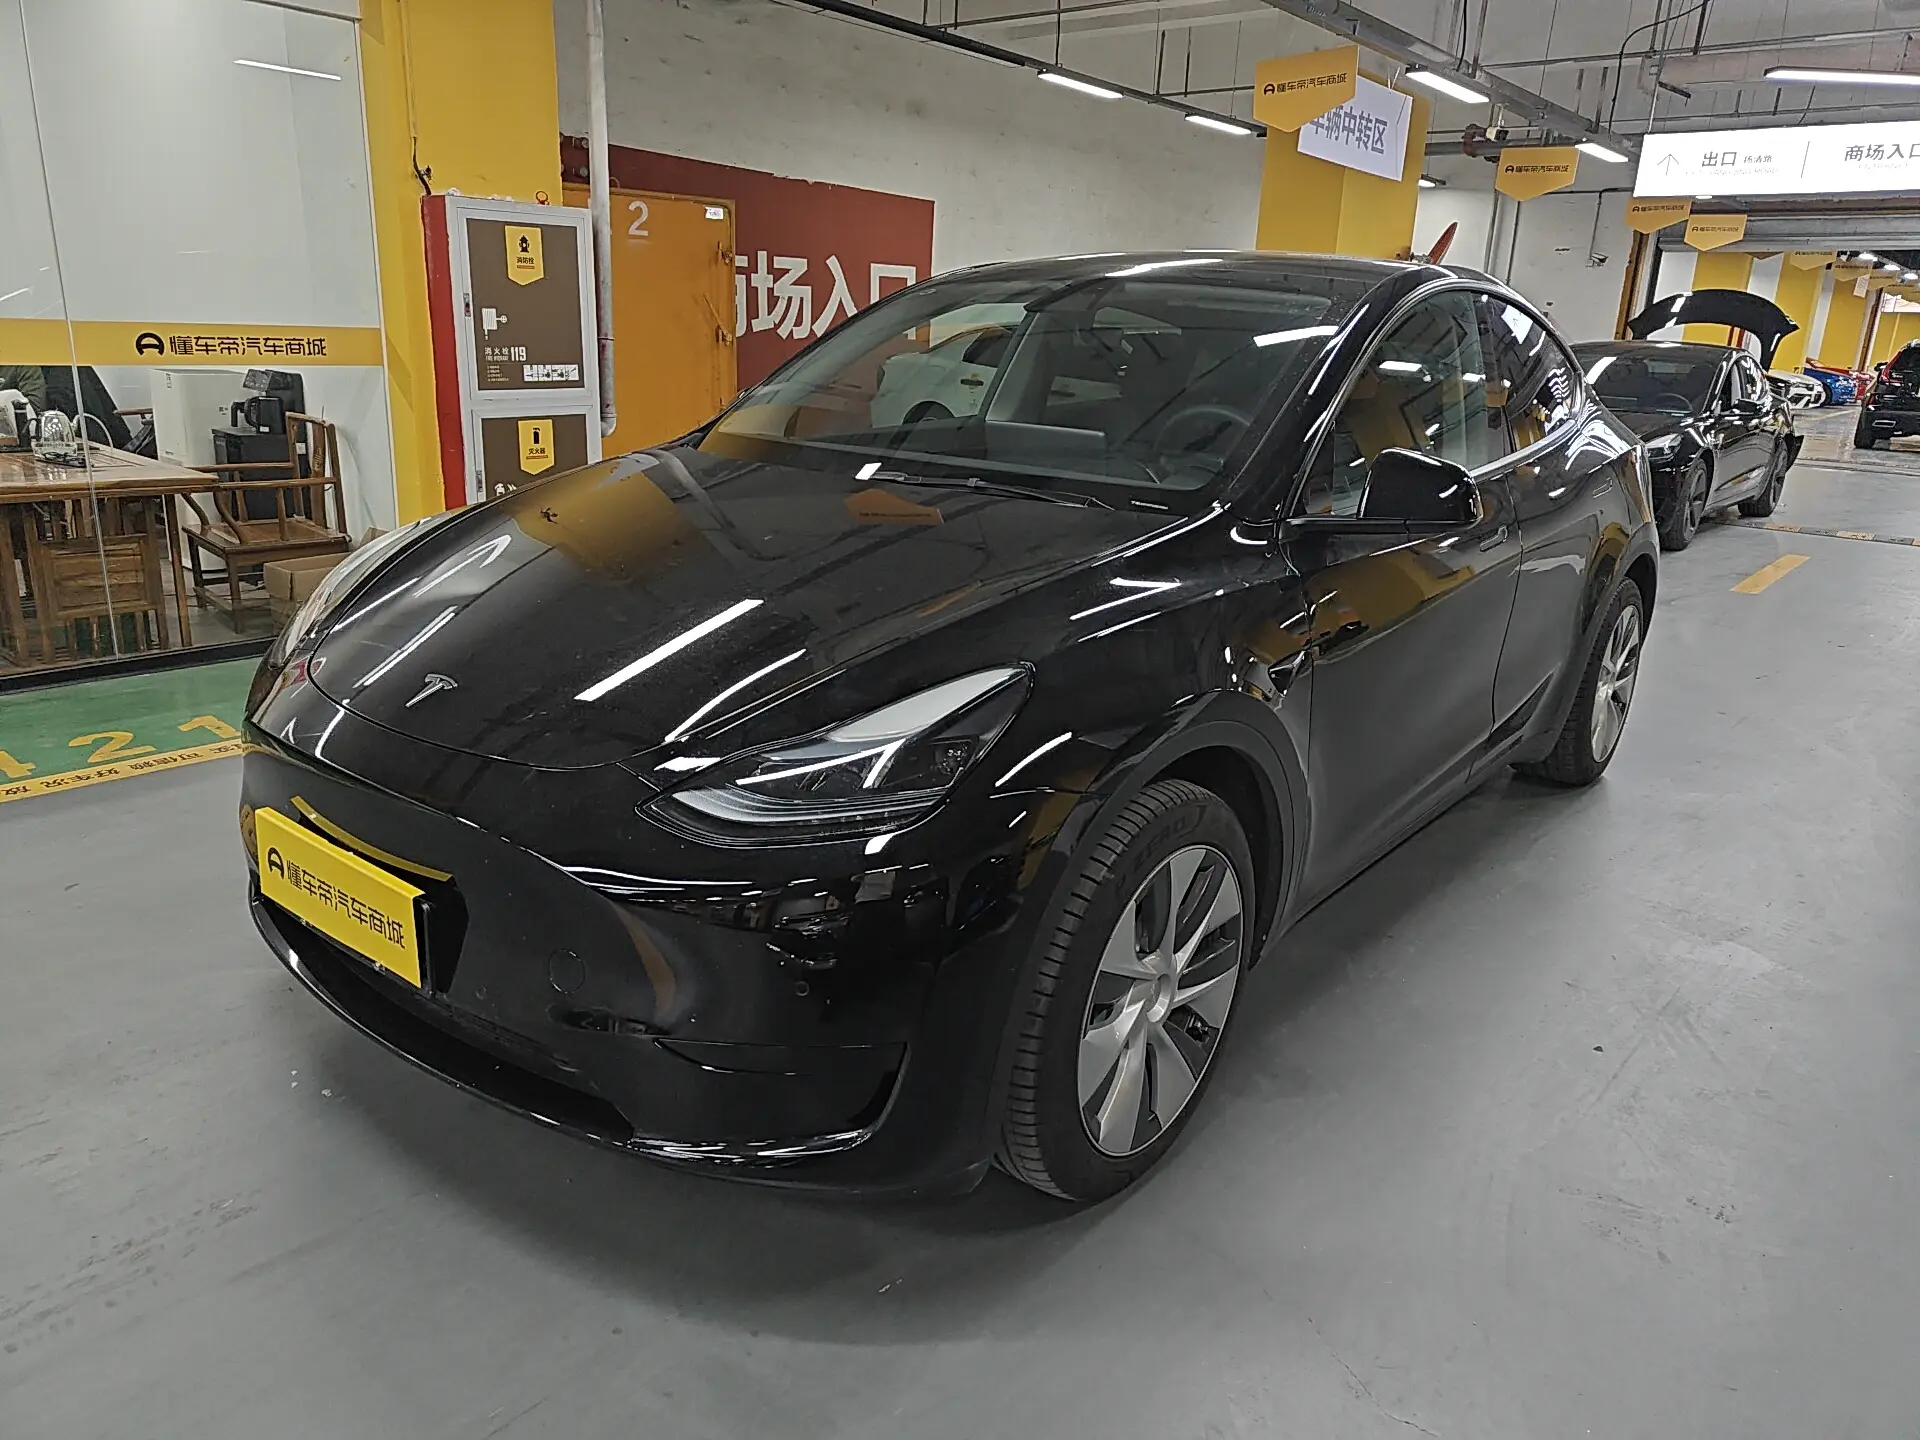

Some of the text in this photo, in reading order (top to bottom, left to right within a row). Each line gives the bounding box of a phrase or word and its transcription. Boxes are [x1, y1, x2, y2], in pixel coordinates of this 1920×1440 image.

[1277, 73, 1347, 93] 懂车帝汽车商城
[1702, 152, 1737, 167] 出口
[735, 249, 917, 341] 场入口
[169, 335, 327, 357] 懂车帝汽车商城
[510, 346, 527, 362] 119
[287, 860, 406, 949] 懂车帝汽车商城
